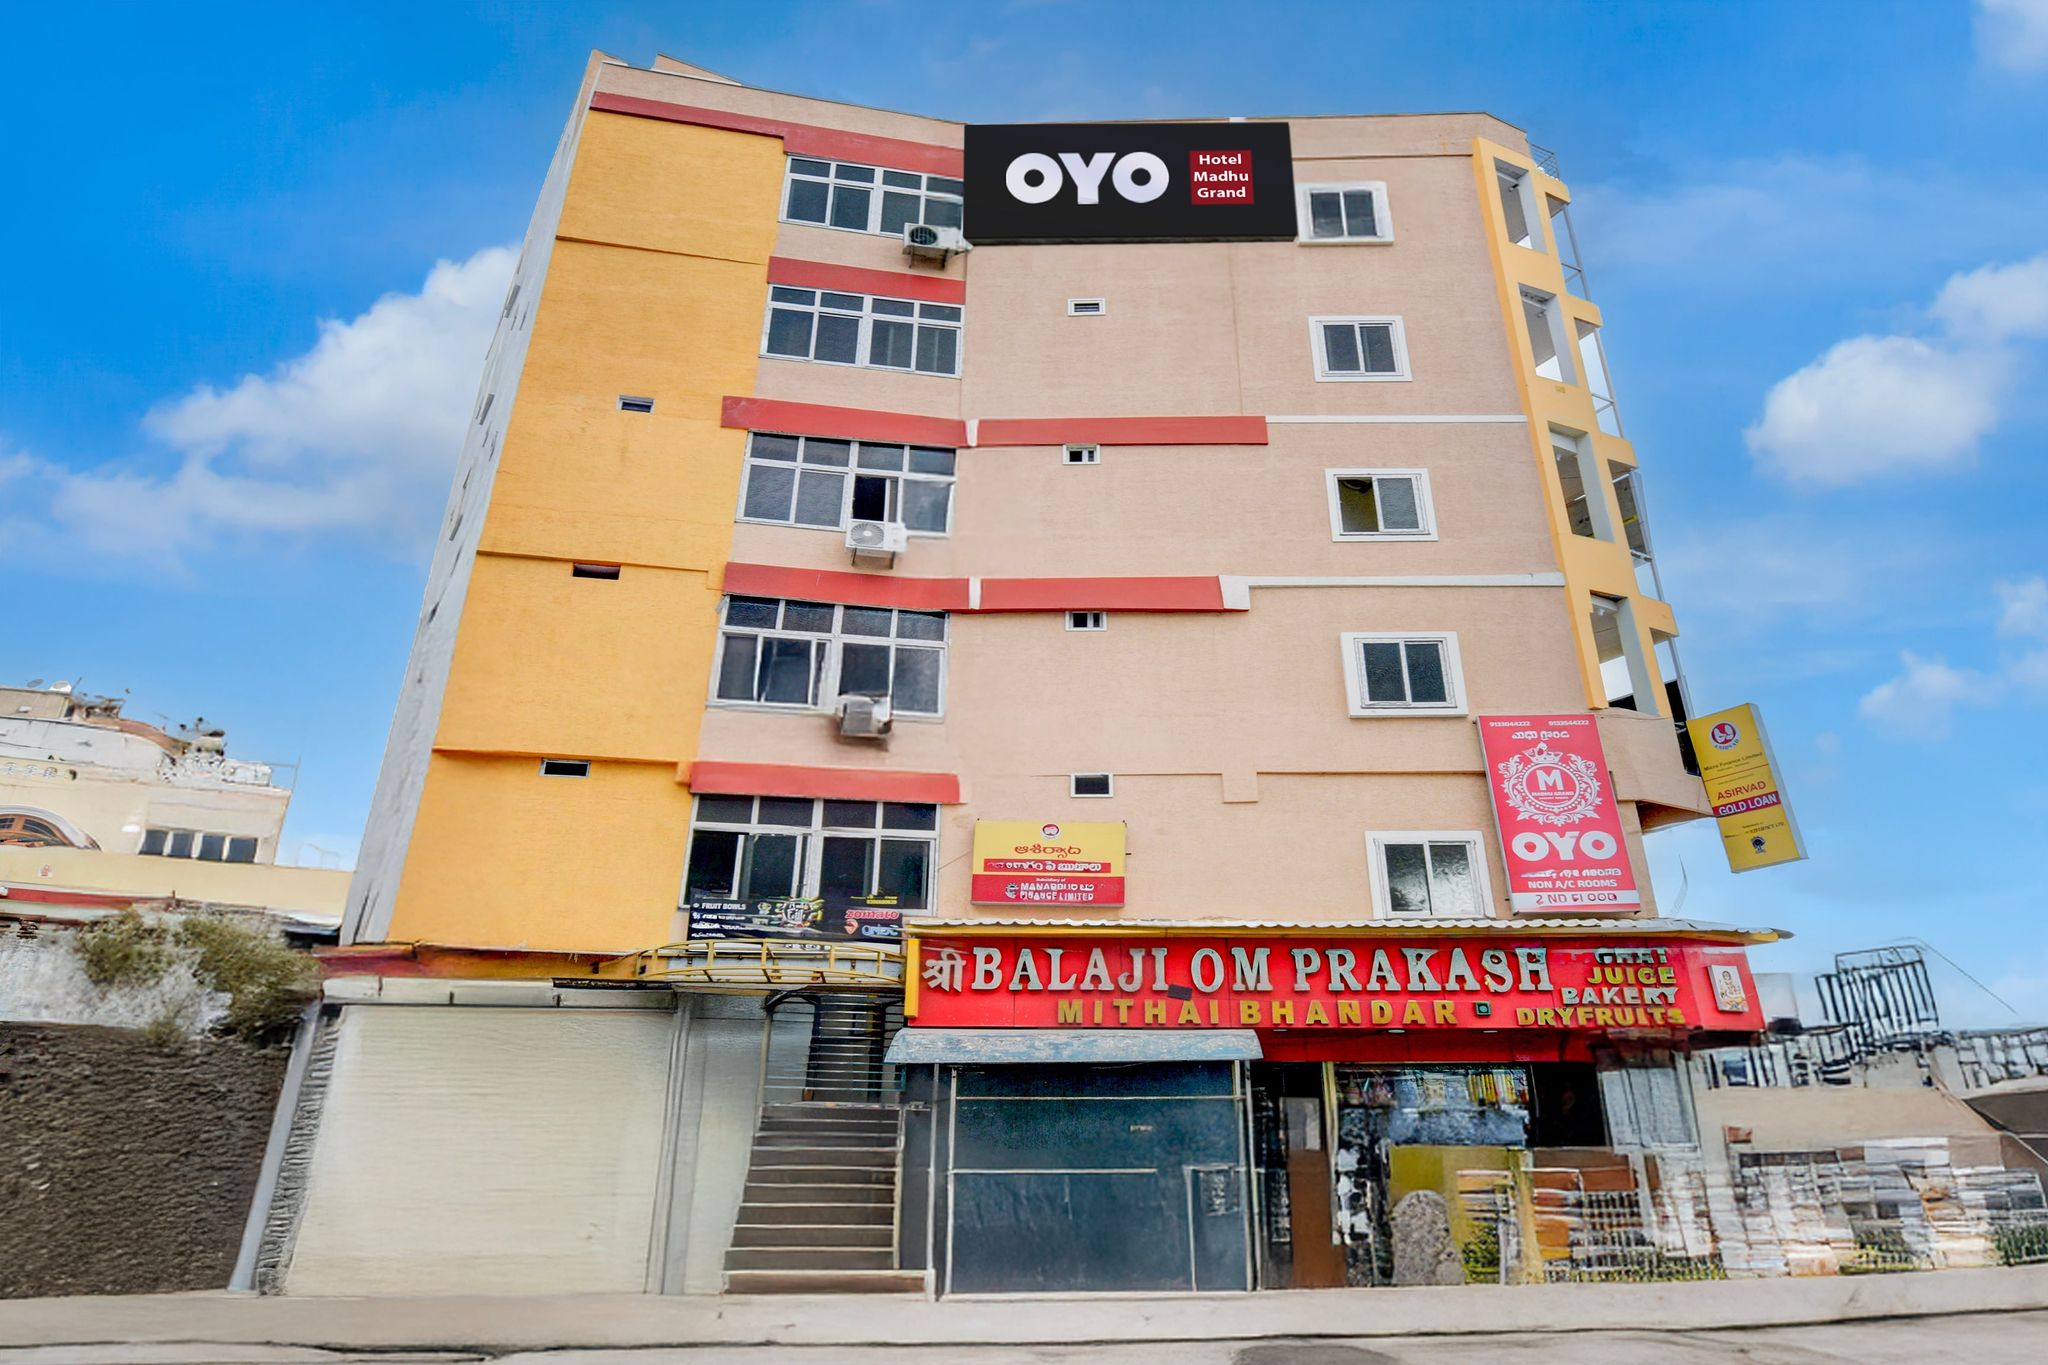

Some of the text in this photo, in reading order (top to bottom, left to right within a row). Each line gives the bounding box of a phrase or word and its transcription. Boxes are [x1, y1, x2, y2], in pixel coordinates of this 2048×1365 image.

[1199, 154, 1242, 166] Hotel
[1006, 152, 1169, 205] OYO
[1194, 170, 1248, 182] Madhu
[1197, 186, 1246, 198] Grand
[1536, 770, 1564, 791] M
[1717, 781, 1767, 800] ASIRVAD
[1718, 794, 1777, 815] GOLD LOAN
[1512, 830, 1618, 862] OYO
[1528, 879, 1618, 889] NON A/C ROOMS
[1059, 892, 1094, 901] LIMITED
[922, 946, 1554, 992] श्री BALAJI OM PRAKASH
[1587, 966, 1677, 984] JUICE
[1561, 986, 1679, 1004] BAKERY
[1058, 998, 1458, 1026] MITHAI BHANDAR
[1516, 1007, 1686, 1026] DRYFRUITS
